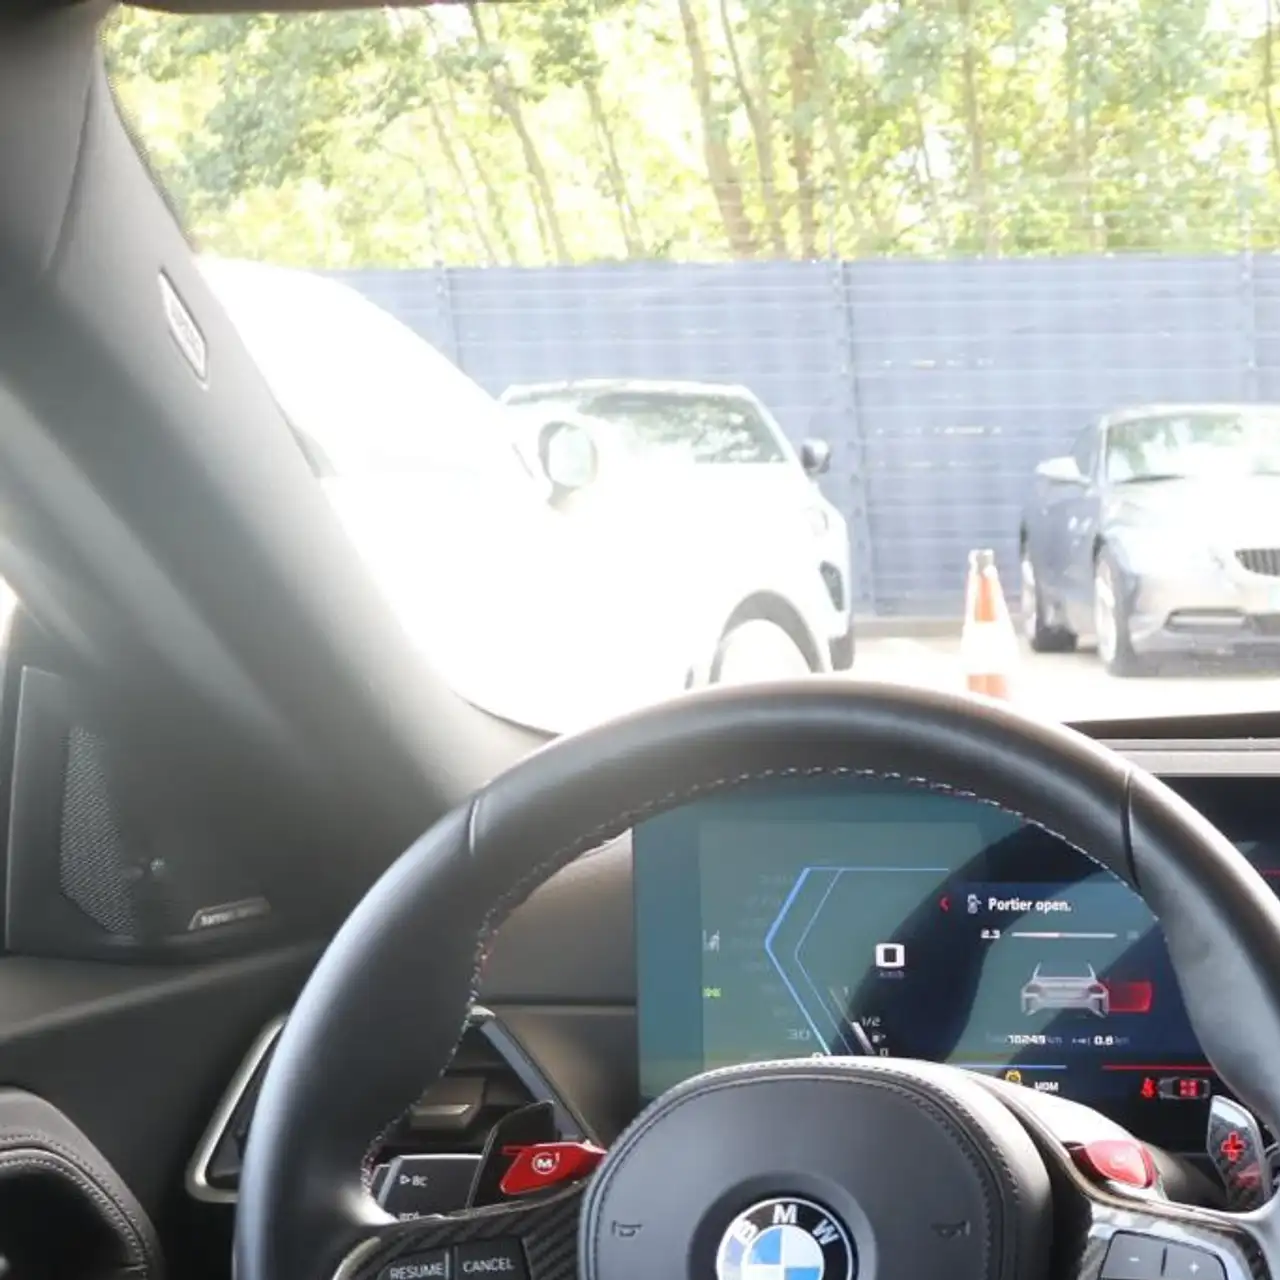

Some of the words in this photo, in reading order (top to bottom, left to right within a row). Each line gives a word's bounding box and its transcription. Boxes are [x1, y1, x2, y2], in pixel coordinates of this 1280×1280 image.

[988, 897, 1032, 911] Portier
[1036, 900, 1072, 914] open.
[876, 943, 905, 969] 0
[732, 1203, 840, 1246] BMW
[390, 1261, 444, 1280] RESUME
[463, 1257, 515, 1274] CANCEL
